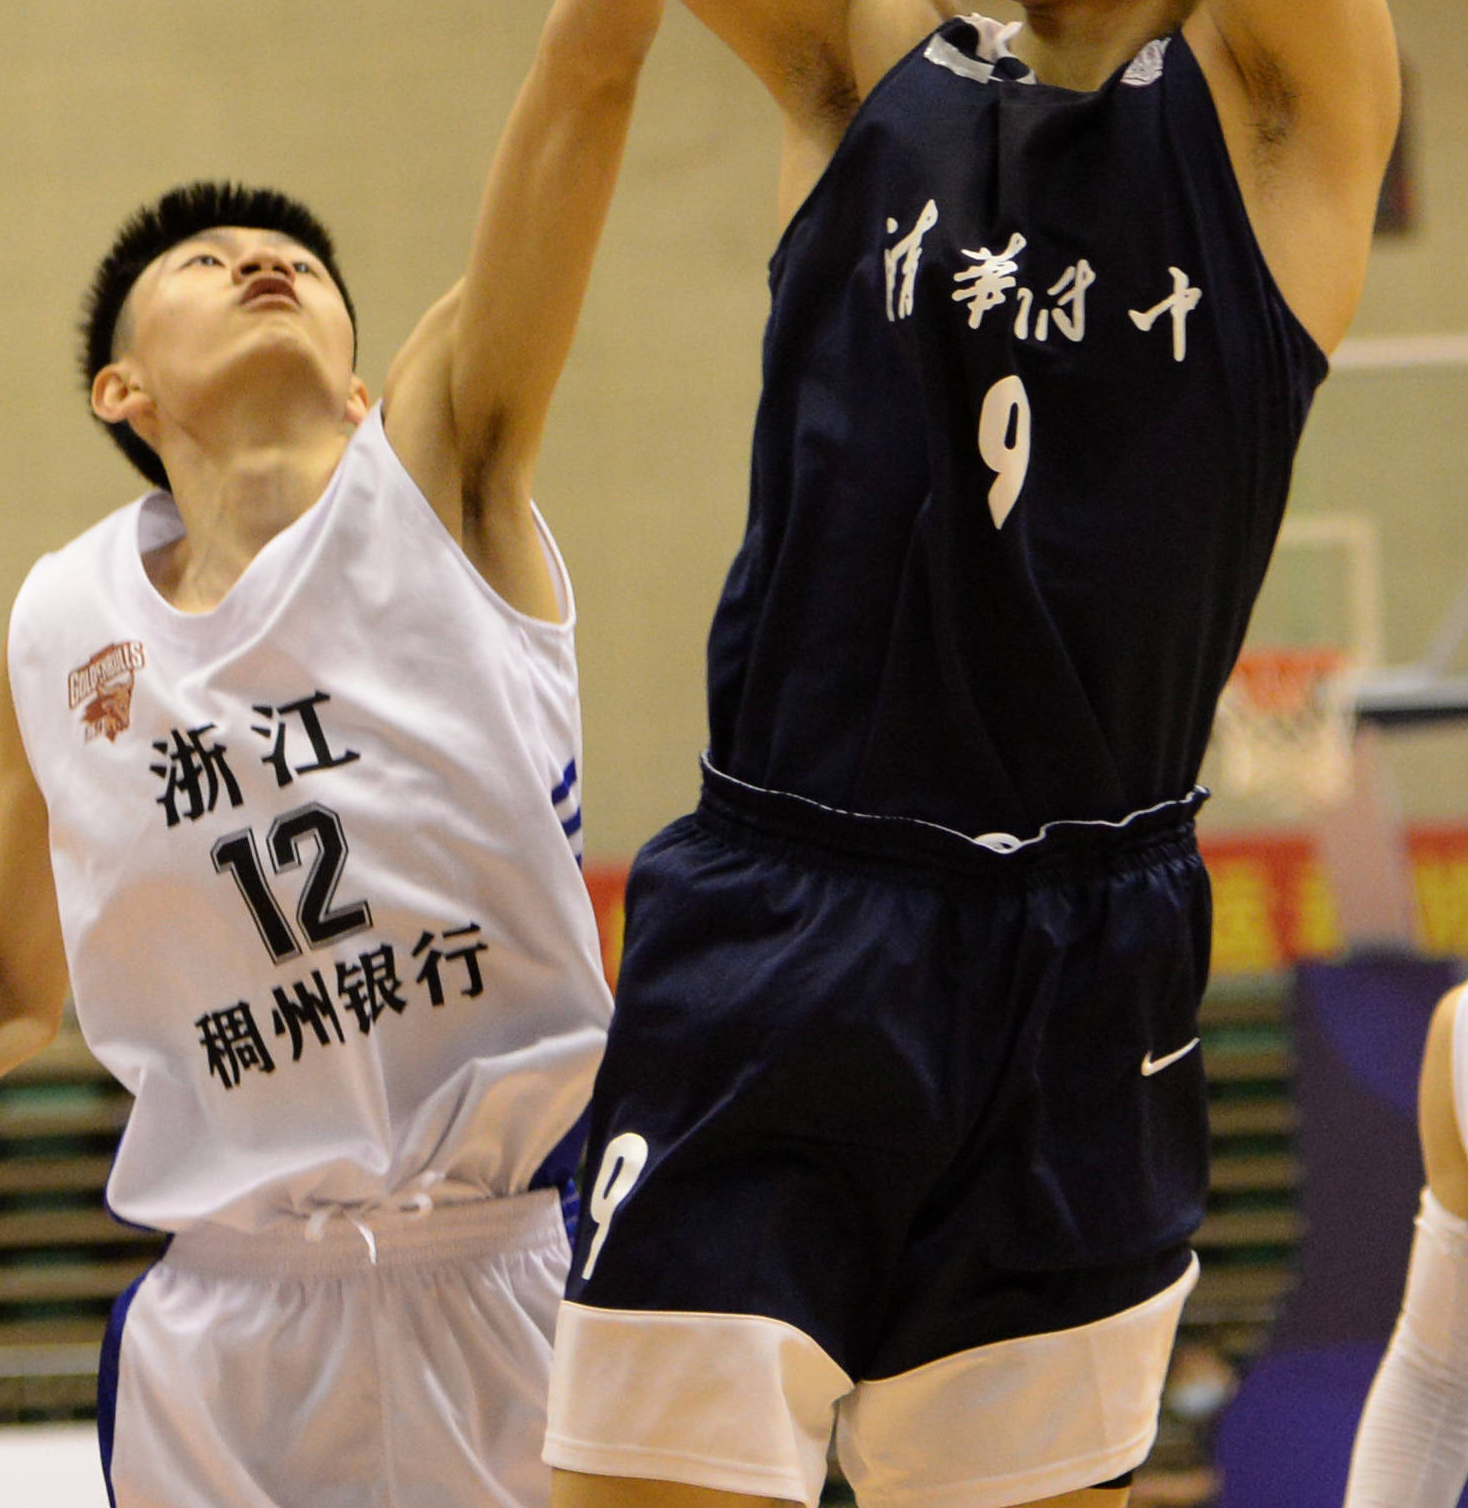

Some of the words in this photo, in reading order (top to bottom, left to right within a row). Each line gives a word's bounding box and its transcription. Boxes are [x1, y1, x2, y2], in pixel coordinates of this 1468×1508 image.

[978, 374, 1032, 531] 9
[148, 690, 361, 828] 浙江
[209, 801, 374, 967] 12
[194, 922, 491, 1090] 稠州银行
[580, 1131, 650, 1281] 9
